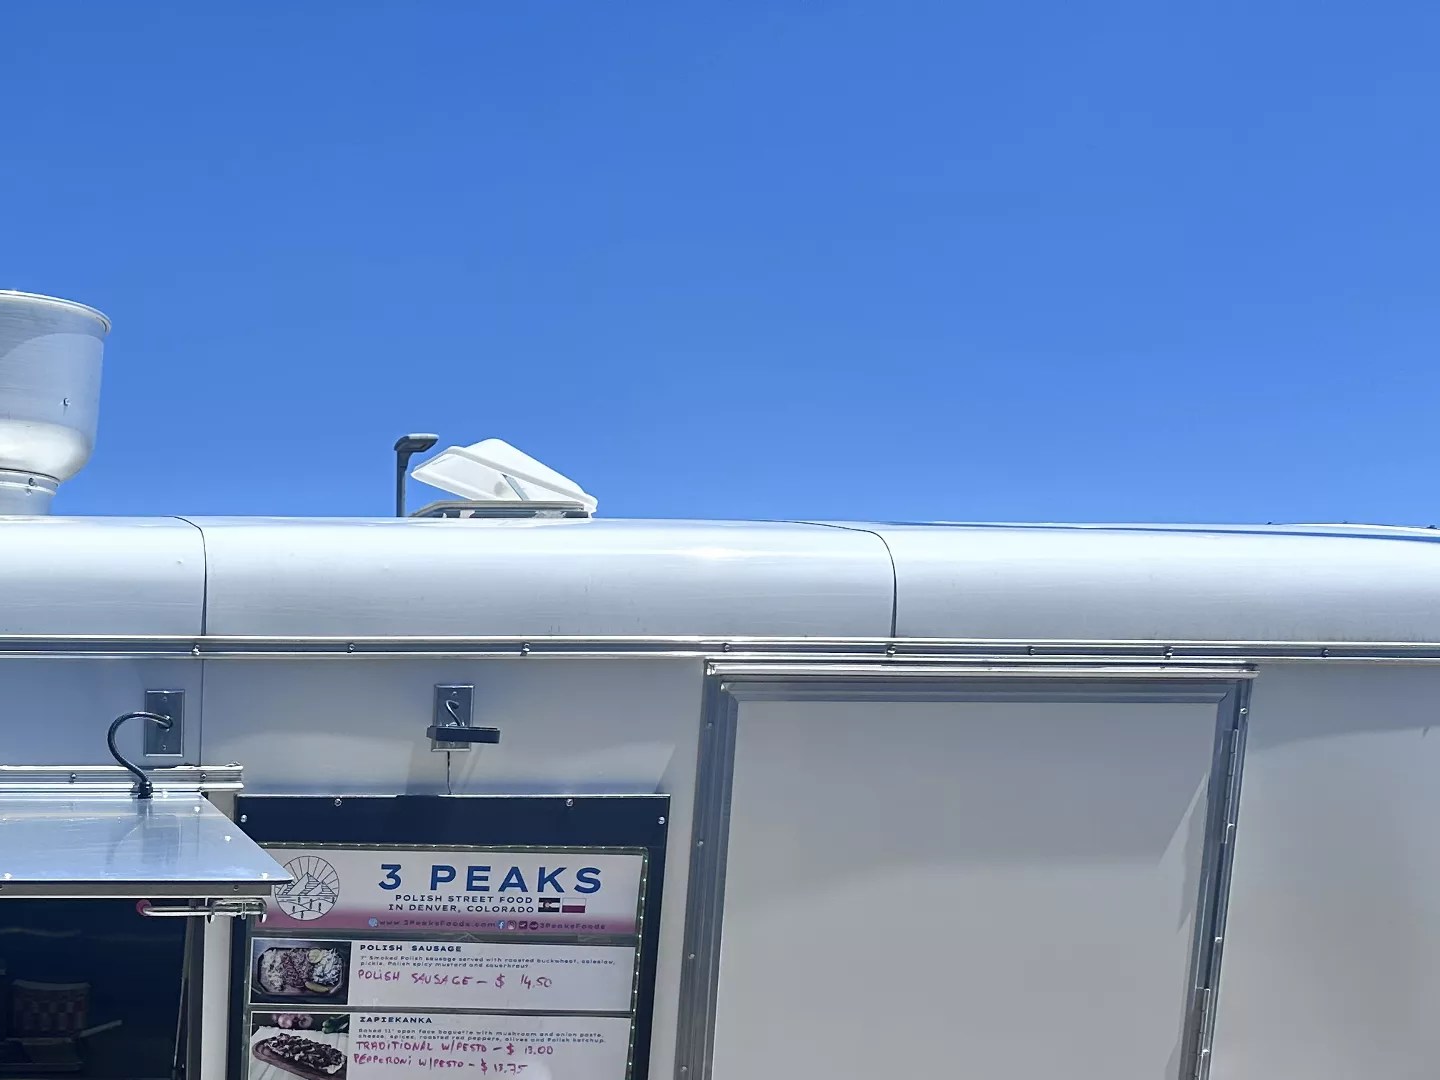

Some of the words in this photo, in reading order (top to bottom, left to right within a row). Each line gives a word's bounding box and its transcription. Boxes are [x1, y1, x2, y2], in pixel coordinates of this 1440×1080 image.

[378, 864, 402, 890] 3
[430, 865, 602, 894] PEAKS
[395, 894, 442, 902] POLISH
[448, 895, 494, 903] STREET
[409, 904, 461, 913] DENVER,
[467, 905, 534, 913] COLORADO
[360, 1016, 433, 1024] ZAPIEKANKA
